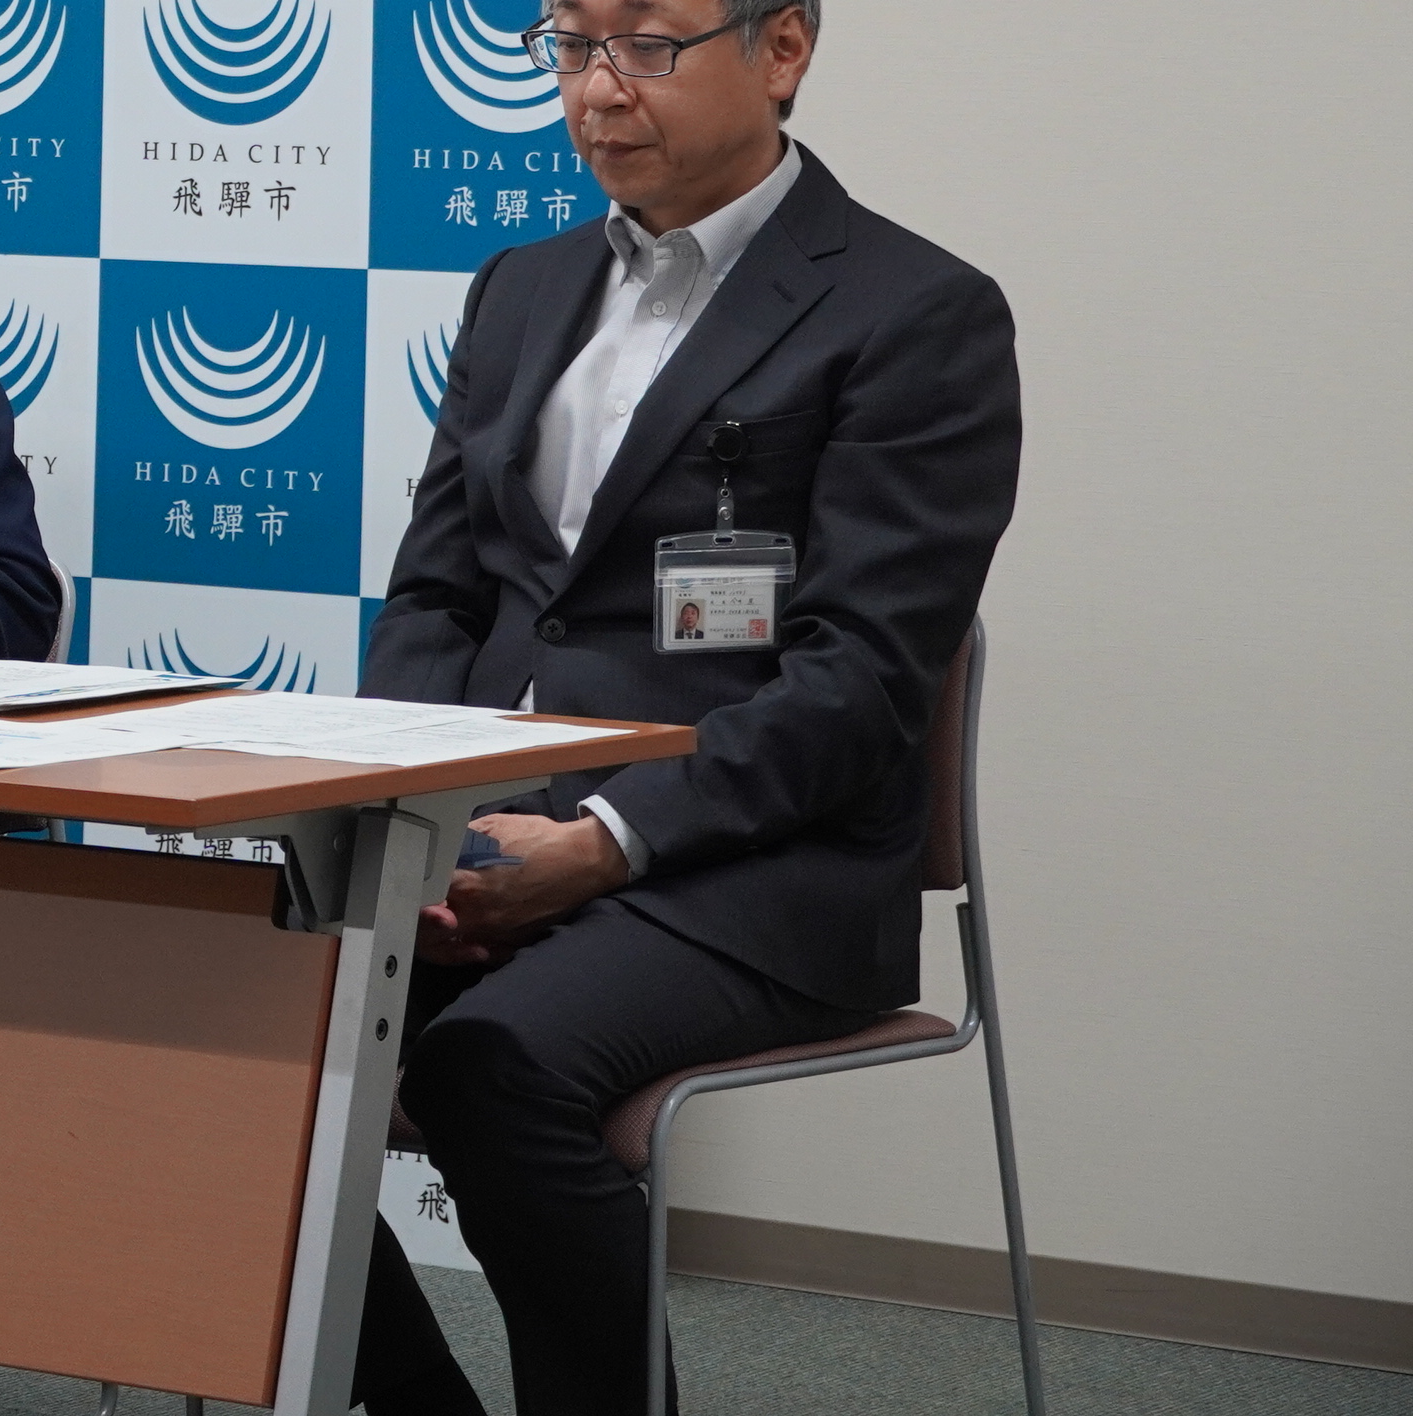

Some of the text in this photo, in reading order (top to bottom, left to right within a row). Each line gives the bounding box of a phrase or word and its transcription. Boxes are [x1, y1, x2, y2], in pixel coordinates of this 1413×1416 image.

[143, 142, 330, 165] HIDA CITY
[413, 148, 582, 173] HIDA CIT
[20, 454, 57, 475] TY
[135, 462, 323, 491] HIDA CITY
